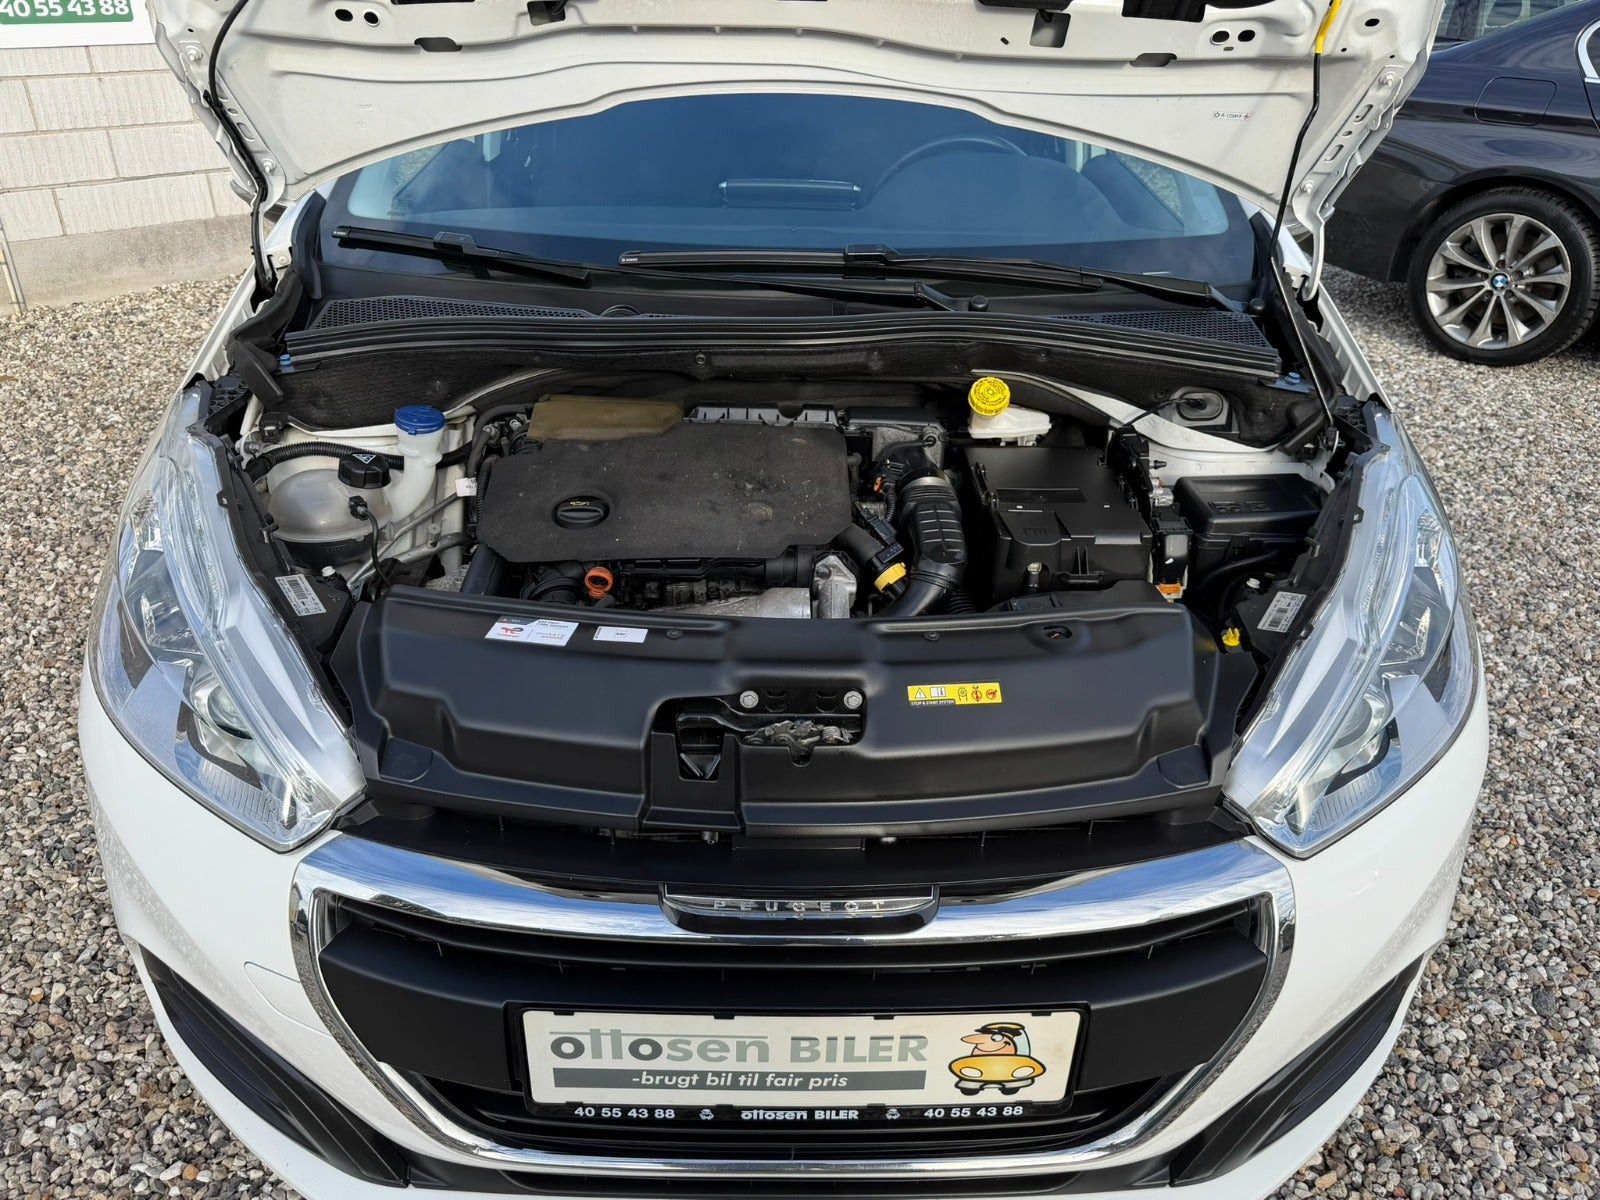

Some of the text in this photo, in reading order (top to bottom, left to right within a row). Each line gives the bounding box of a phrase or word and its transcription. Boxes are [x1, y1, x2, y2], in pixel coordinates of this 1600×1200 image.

[0, 0, 130, 17] 40 55 43 88
[713, 900, 885, 912] PEUGEOT
[550, 1028, 928, 1063] ottosen BILER
[632, 1071, 848, 1090] -brugt bil til fair pris
[574, 1107, 675, 1119] 40 55 43 88
[741, 1110, 859, 1120] ottosen BILER
[924, 1105, 1023, 1118] 40 55 43 88
